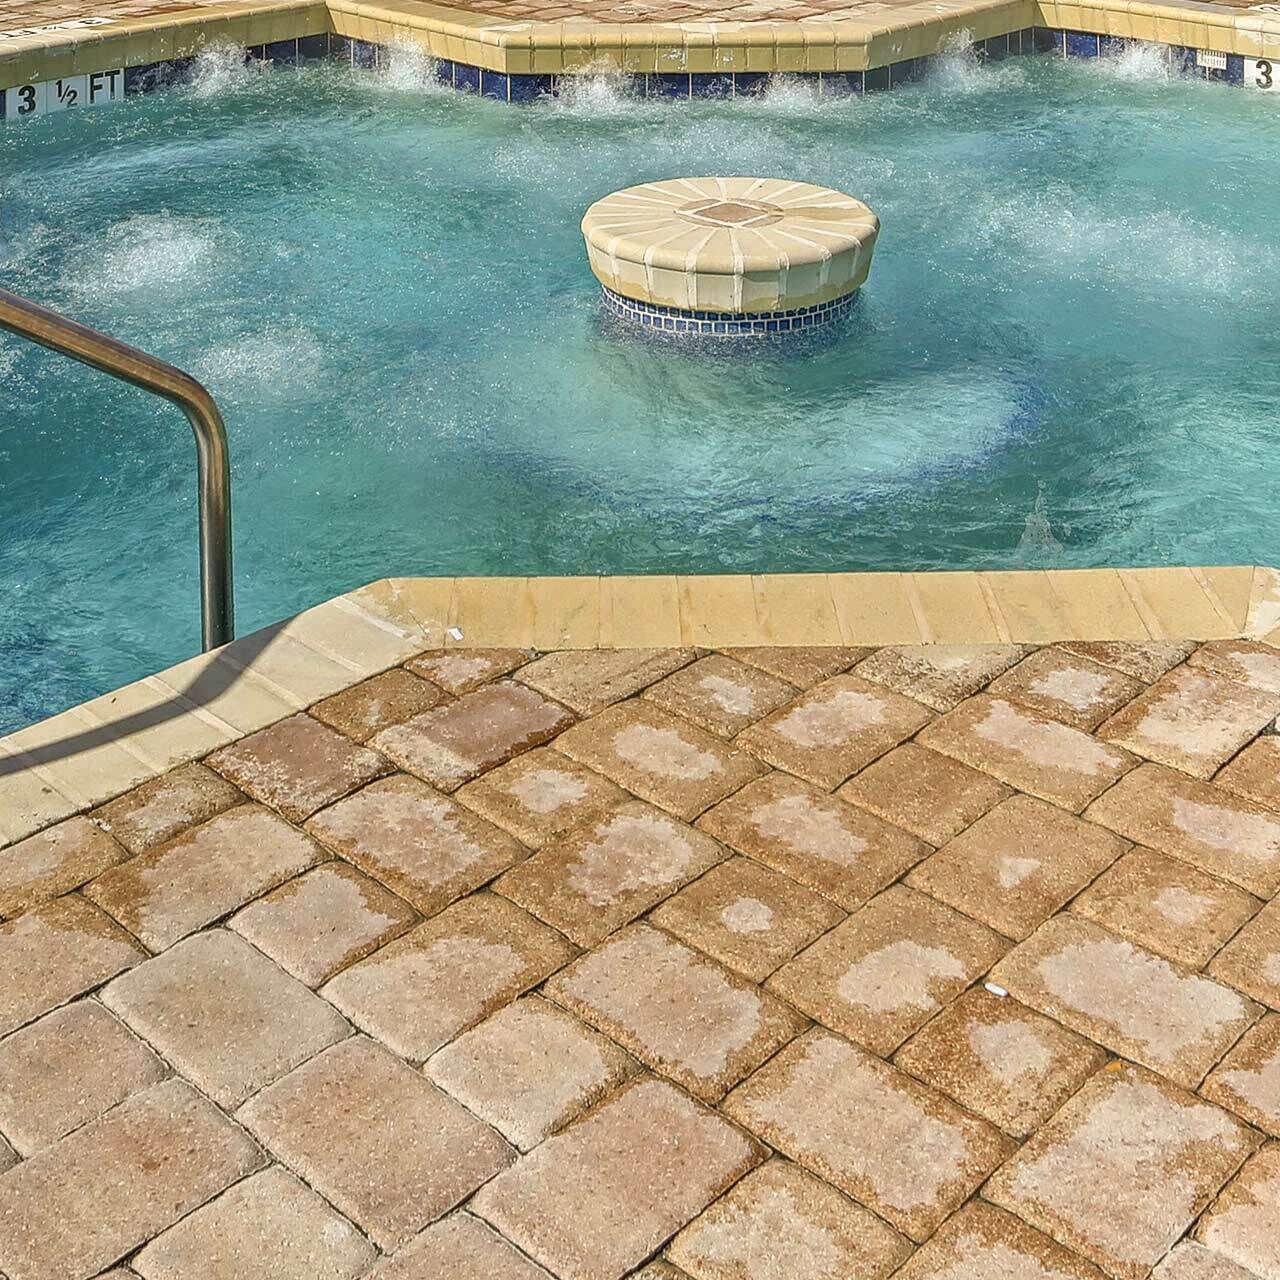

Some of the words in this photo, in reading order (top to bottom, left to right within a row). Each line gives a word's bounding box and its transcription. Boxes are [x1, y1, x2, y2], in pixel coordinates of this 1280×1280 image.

[17, 85, 36, 115] 3
[89, 70, 120, 104] FT
[1255, 60, 1272, 89] 3
